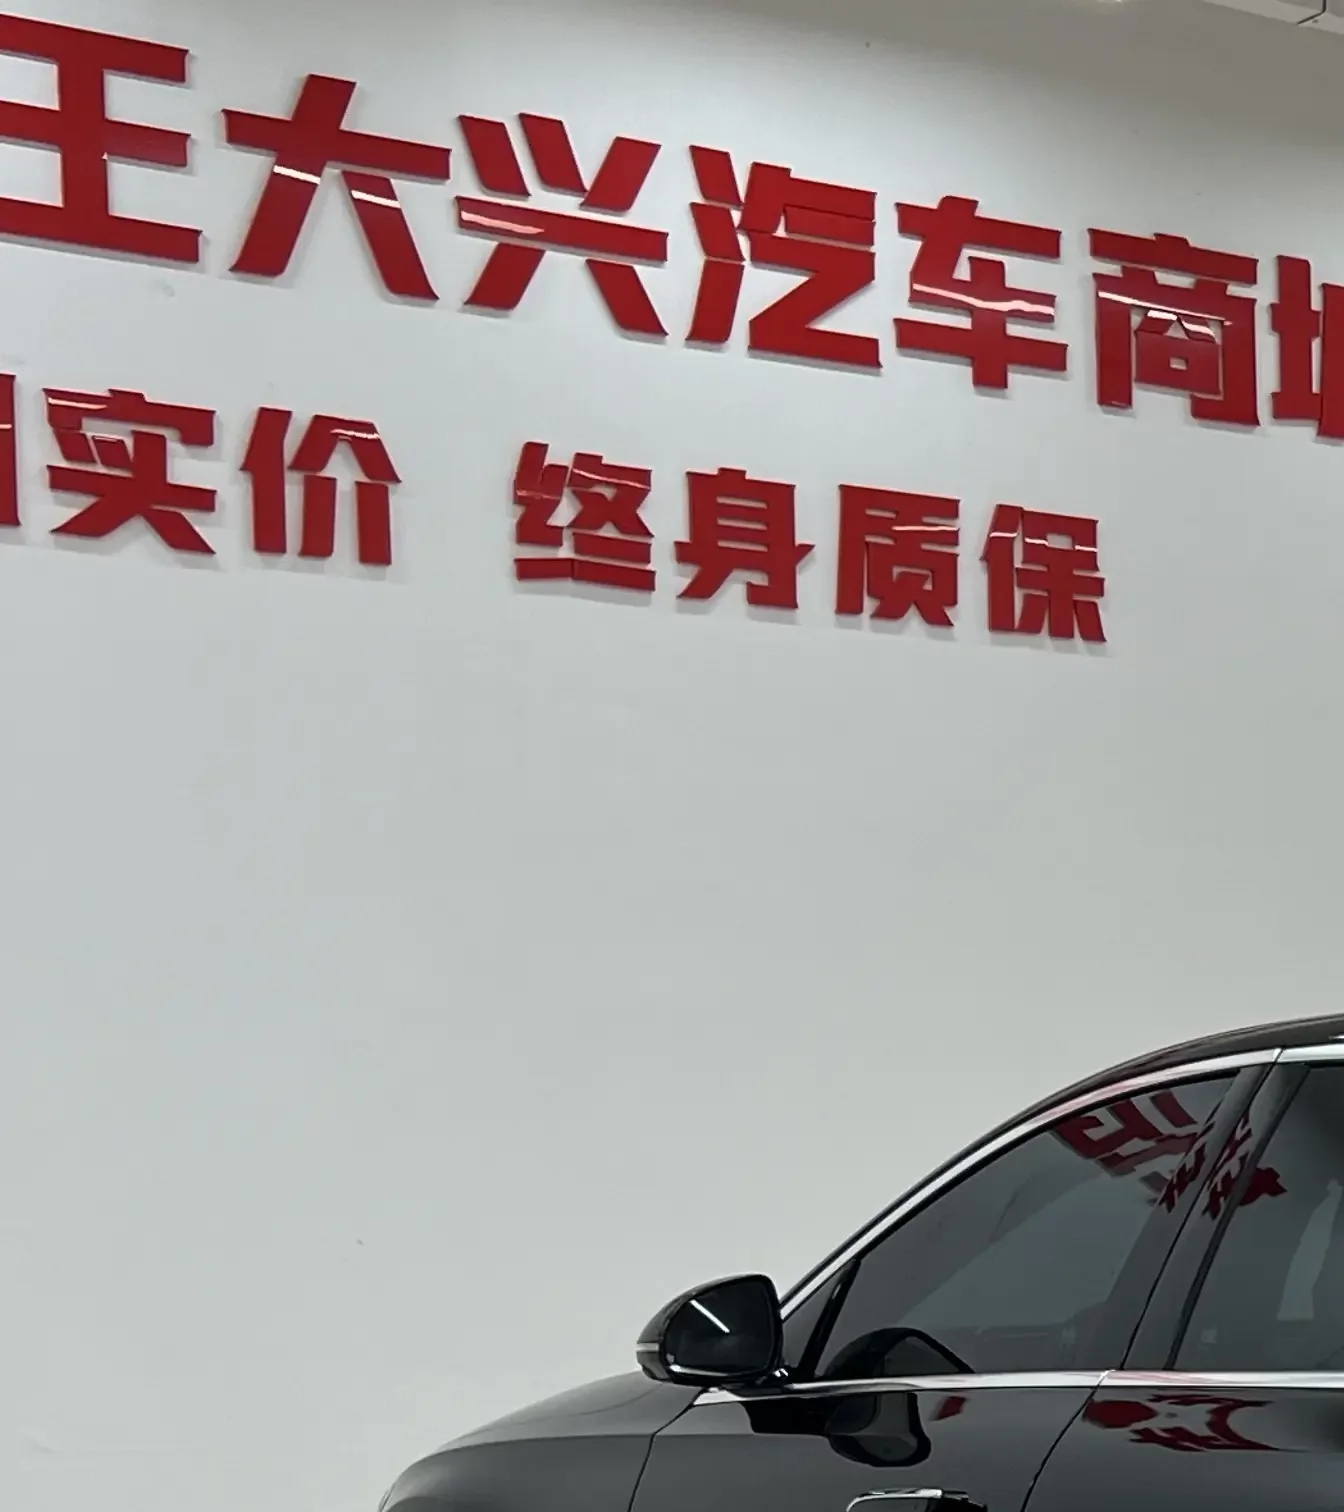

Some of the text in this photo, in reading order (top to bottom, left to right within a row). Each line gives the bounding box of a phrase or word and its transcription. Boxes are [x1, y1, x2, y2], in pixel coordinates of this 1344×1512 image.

[0, 373, 1106, 641] 实价 终身质保
